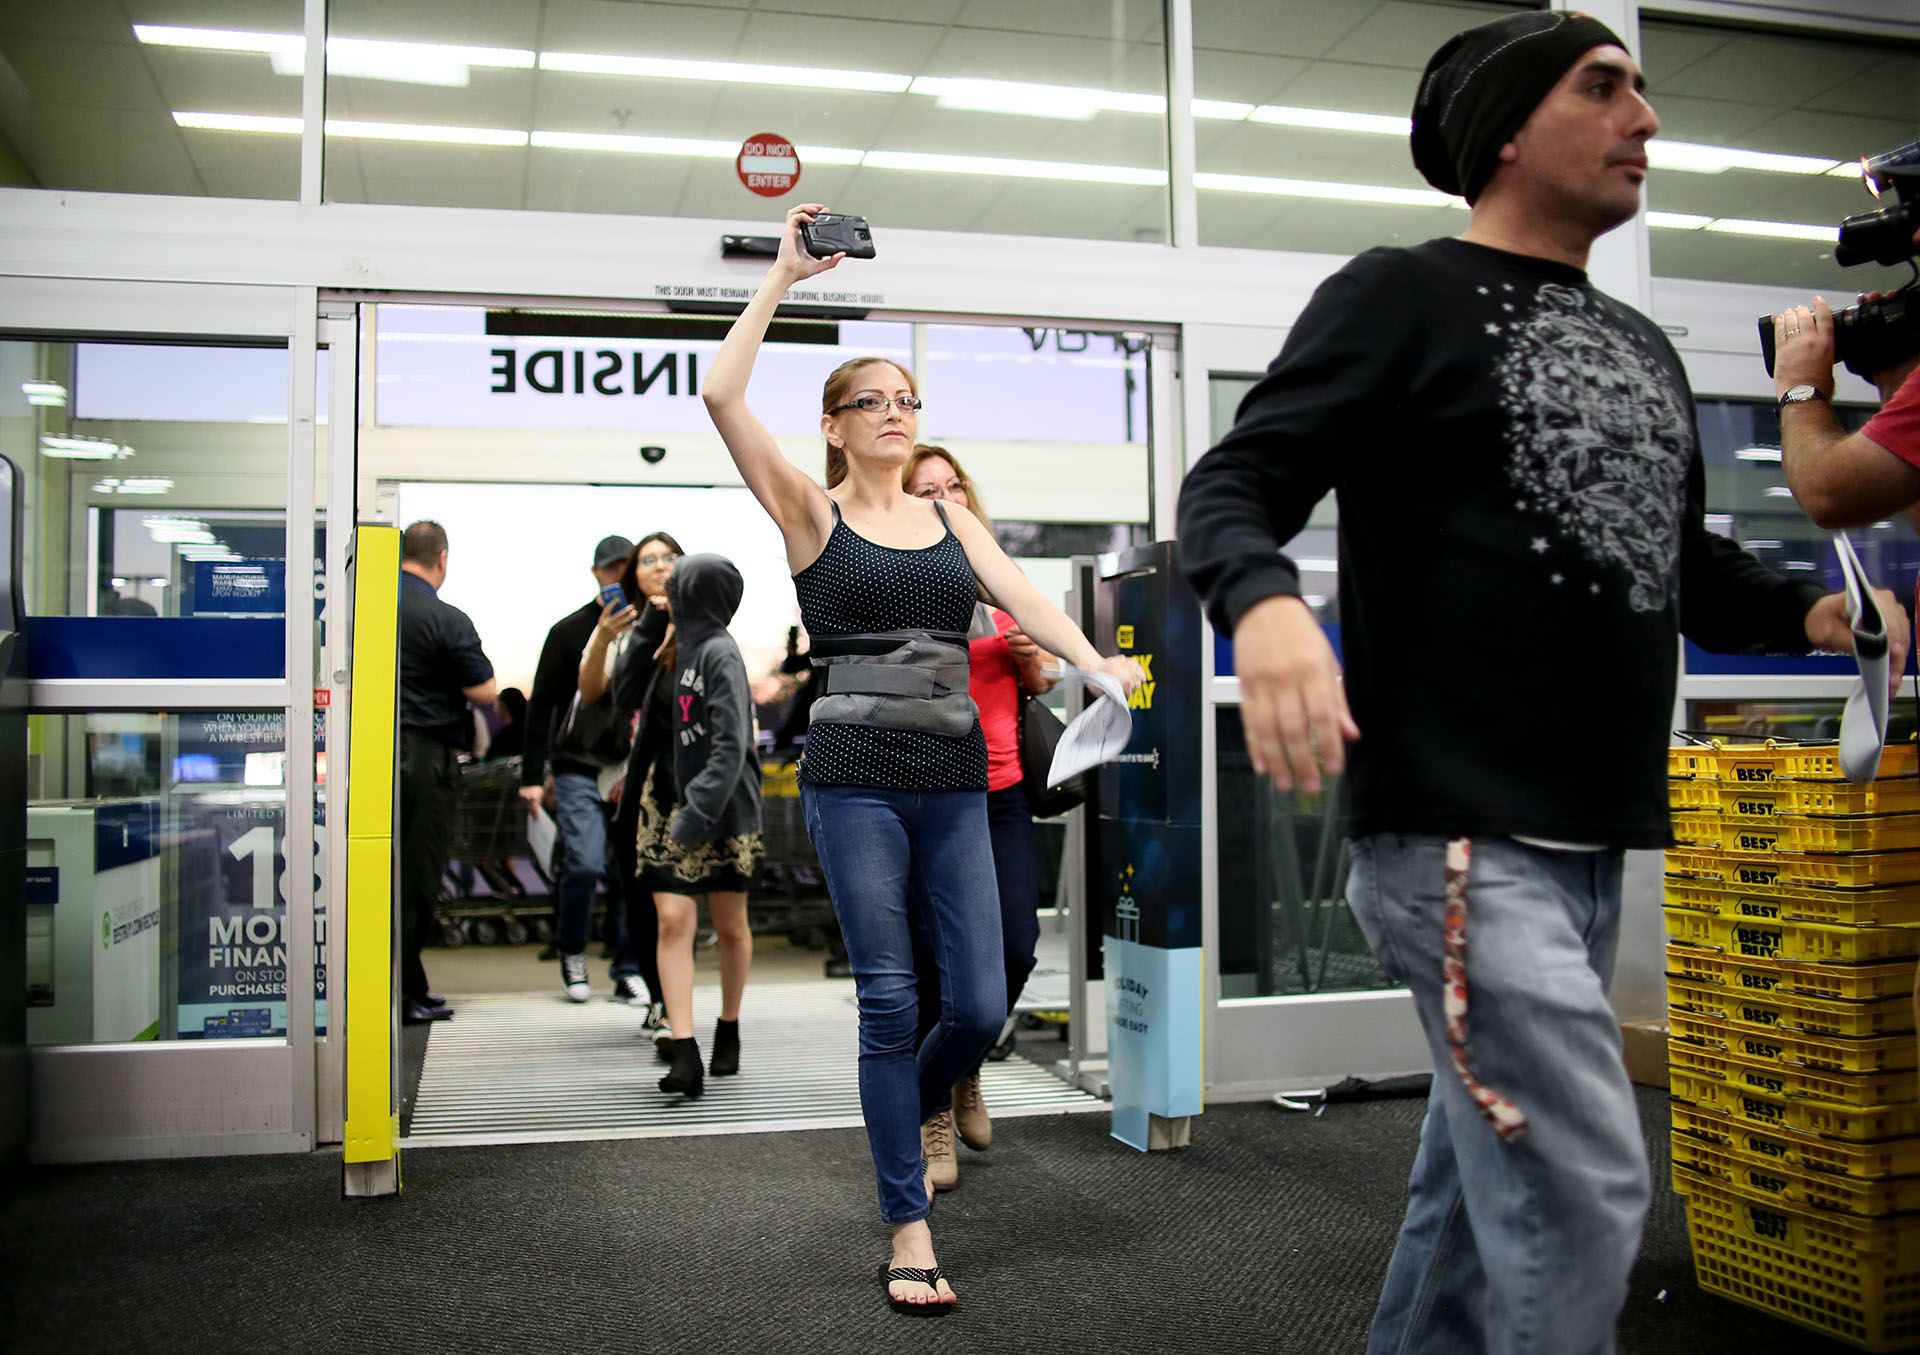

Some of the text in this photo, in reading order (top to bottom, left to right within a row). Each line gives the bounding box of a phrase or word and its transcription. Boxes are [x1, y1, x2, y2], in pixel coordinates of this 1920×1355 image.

[744, 142, 792, 157] DO NOT
[747, 175, 792, 188] ENTER
[655, 286, 671, 296] THIS
[675, 286, 694, 297] DOOR
[697, 287, 718, 298] MUST
[679, 695, 693, 722] Y
[216, 713, 234, 723] ON
[236, 713, 265, 722] YOUR
[203, 722, 282, 733] WHEN YOU ARE
[209, 733, 283, 743] A MY BEST BUY
[1736, 768, 1773, 782] BEST
[226, 809, 274, 819] LIMITED
[1738, 802, 1775, 816] BEST
[1740, 836, 1777, 850] BEST
[1740, 870, 1778, 885] BEST
[1741, 903, 1778, 919] BEST
[1738, 928, 1782, 948] BEST
[235, 970, 256, 982] ON
[1742, 974, 1779, 991] BEST
[209, 981, 287, 996] PURCHASES
[1743, 1007, 1780, 1025] BEST
[1745, 1041, 1783, 1058] BEST
[1746, 1074, 1784, 1092] BEST
[1743, 1097, 1784, 1120] BEST
[1749, 1137, 1786, 1158] BEST
